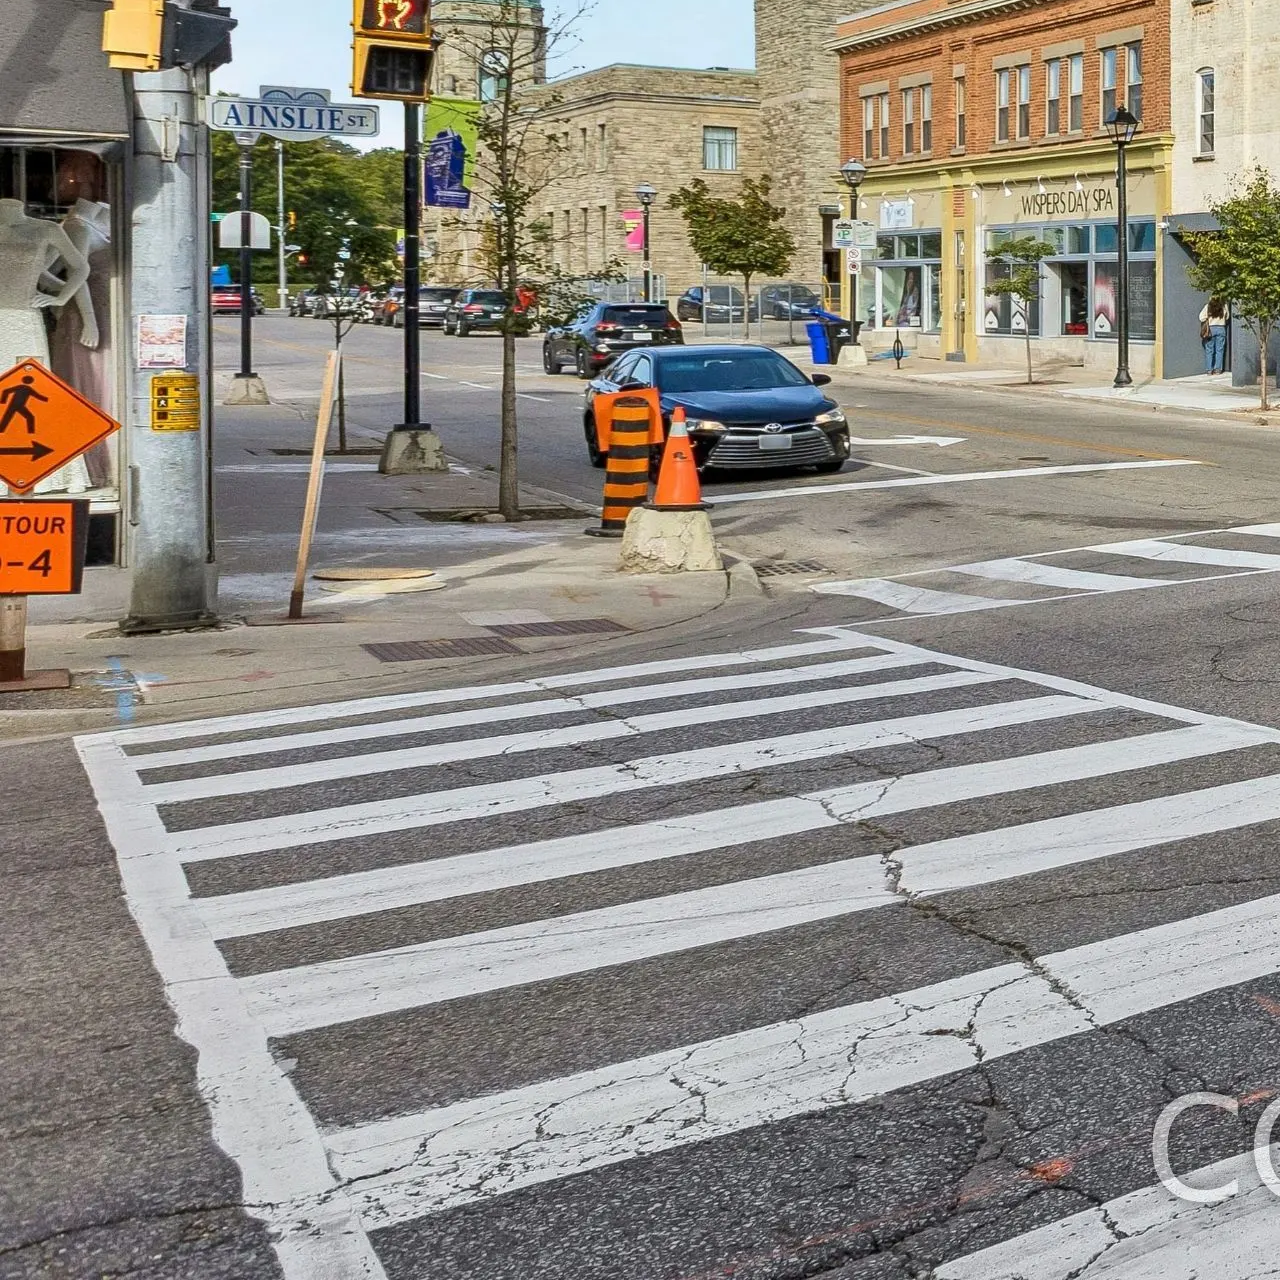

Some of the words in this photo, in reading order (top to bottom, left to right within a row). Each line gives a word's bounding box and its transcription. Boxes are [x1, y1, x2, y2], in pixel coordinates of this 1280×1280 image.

[223, 103, 344, 131] AINSLIE
[347, 115, 369, 128] ST.
[1021, 192, 1066, 216] WISPERS
[1068, 189, 1091, 213] DAY
[1092, 188, 1114, 212] SPA
[0, 516, 66, 535] TOUR
[0, 548, 52, 578] -4
